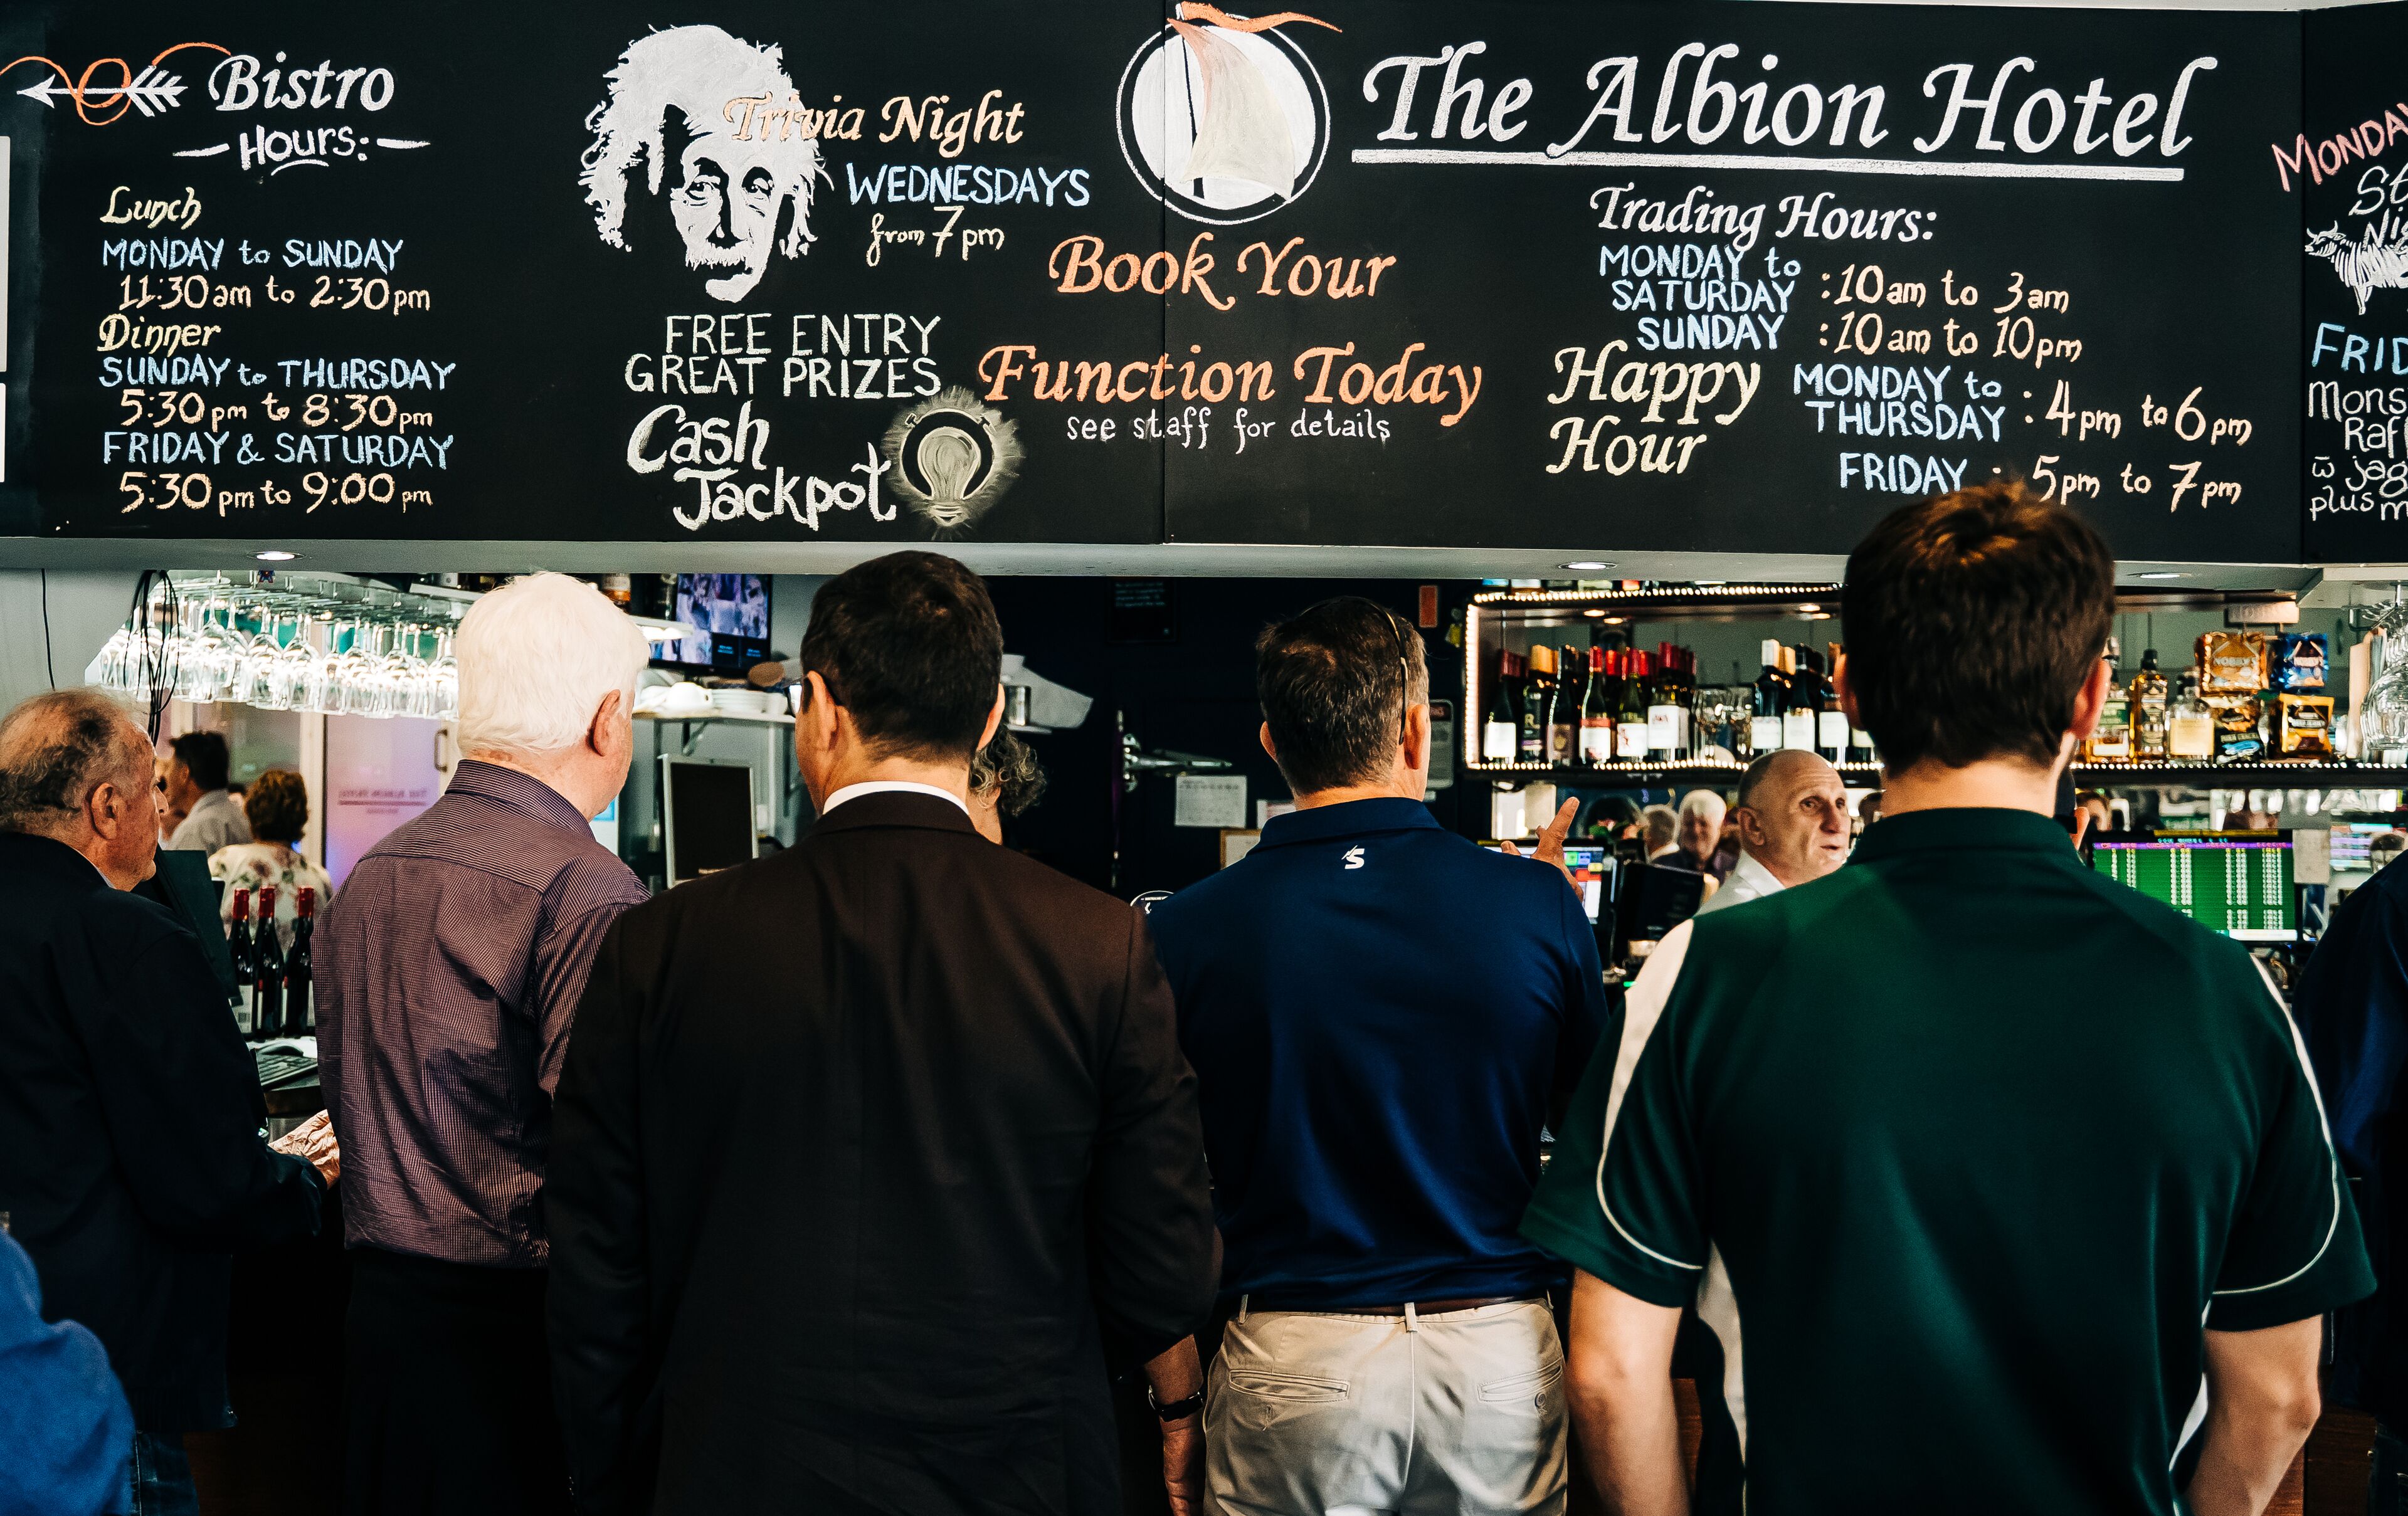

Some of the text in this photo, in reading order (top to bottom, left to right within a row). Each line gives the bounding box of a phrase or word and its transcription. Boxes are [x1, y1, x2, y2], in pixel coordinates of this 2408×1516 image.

[208, 50, 394, 112] Bistro
[1363, 41, 2218, 160] The Albion Hotel
[721, 89, 1025, 159] Trivia Night
[240, 125, 369, 170] Hours:
[845, 162, 1090, 208] WEDNESDAYS
[99, 186, 202, 230] Lunch
[1590, 182, 1937, 251] Trading Hours:
[102, 236, 404, 275] MONDAY to SUNDAY
[865, 213, 926, 267] from
[1599, 243, 1802, 282] MONDAY to
[265, 275, 295, 304] to
[1048, 231, 1397, 311] Book Your
[1611, 278, 1795, 314] SATURDAY
[1941, 269, 1978, 306] to
[97, 313, 222, 357] Dinner
[665, 312, 941, 357] FREE ENTRY
[1636, 314, 1785, 351] SUNDAY
[1945, 317, 1978, 357] to
[98, 353, 457, 391] SUNDAY to THURSDAY
[624, 353, 941, 399] GREAT PRIZES
[978, 341, 1482, 427] Function Today
[1546, 339, 1761, 426] Happy
[1793, 363, 2002, 403] MONDAY to
[260, 392, 290, 421] to
[1804, 400, 2006, 442] THURSDAY
[2141, 394, 2168, 428] to
[103, 431, 454, 470] FRIDAY & SATURDAY
[626, 399, 770, 476] Cash
[1067, 406, 1392, 455] see staff for details
[1545, 414, 1708, 476] Hour
[260, 480, 292, 505] to
[672, 441, 897, 532] Jackpot
[1839, 452, 1970, 497] FRIDAY
[2120, 462, 2152, 494] to
[2309, 482, 2375, 522] plus
